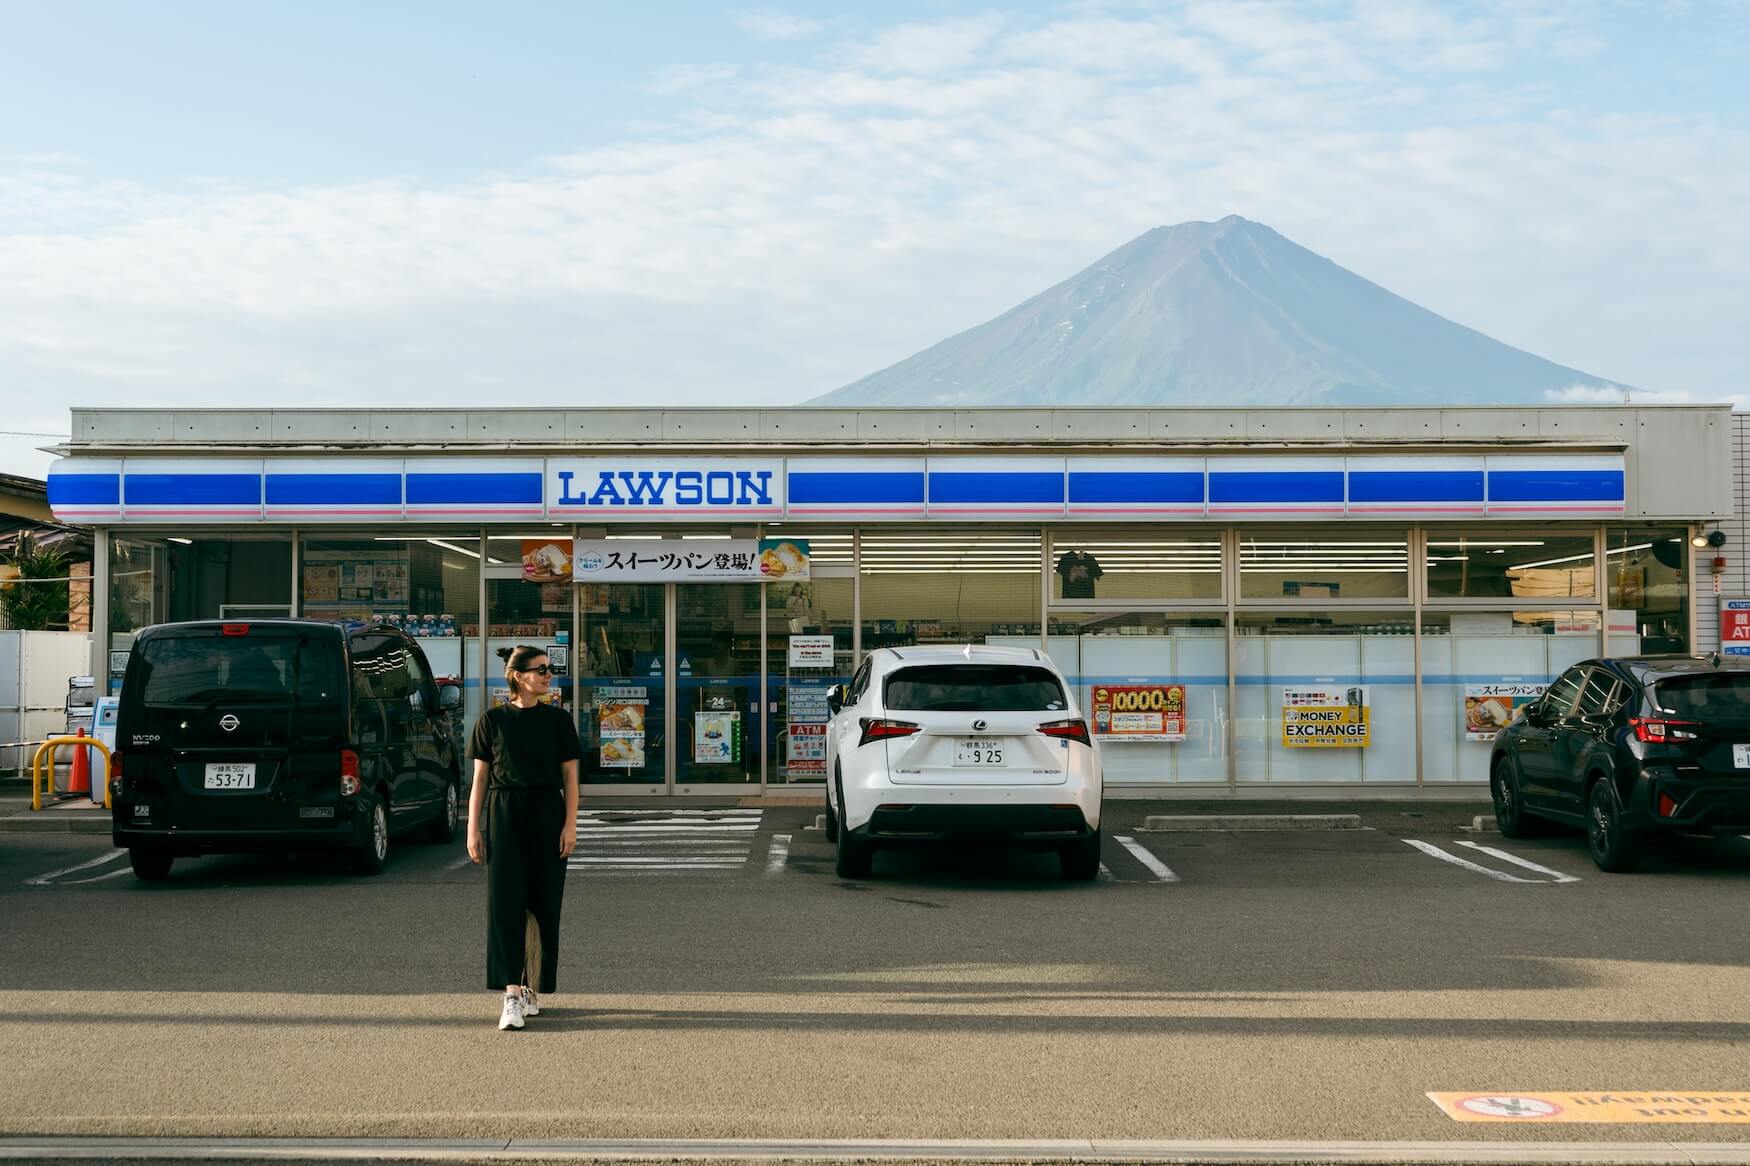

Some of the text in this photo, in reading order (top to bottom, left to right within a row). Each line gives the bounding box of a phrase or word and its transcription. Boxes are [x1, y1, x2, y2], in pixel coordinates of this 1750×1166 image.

[558, 471, 773, 506] LAWSON
[712, 697, 725, 706] 24
[1300, 711, 1342, 721] MONEY
[796, 726, 821, 734] ATM
[1286, 724, 1366, 736] EXCHANGE
[986, 750, 1002, 763] 25
[1634, 1107, 1708, 1117] out
